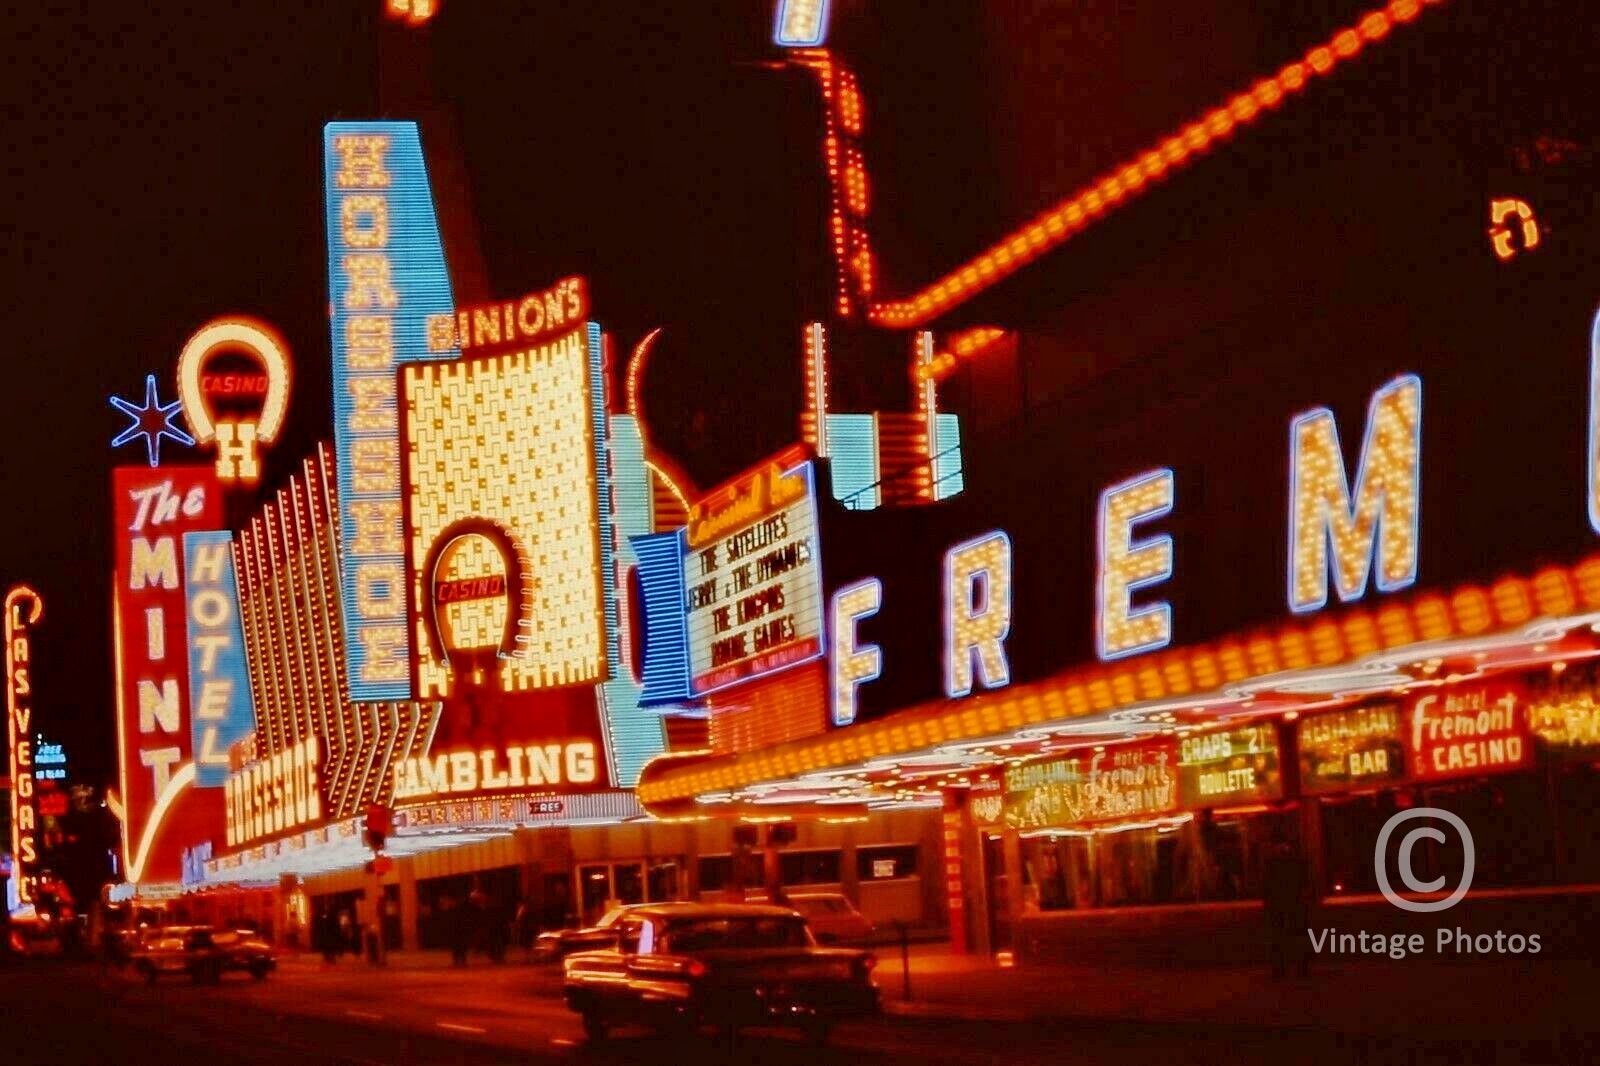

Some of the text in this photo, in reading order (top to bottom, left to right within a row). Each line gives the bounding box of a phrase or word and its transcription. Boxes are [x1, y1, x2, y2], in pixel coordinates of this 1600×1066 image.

[425, 276, 582, 352] BINION'S
[201, 376, 268, 393] CASINO
[332, 133, 408, 682] HORSESHOE
[215, 422, 258, 478] H
[129, 480, 206, 531] The
[699, 511, 788, 576] THE SATELLITES
[439, 578, 501, 601] CASINO
[732, 563, 752, 594] THE
[712, 604, 731, 634] THE
[13, 605, 30, 694] LAS
[129, 535, 182, 800] MINT
[189, 543, 232, 766] HOTEL
[394, 742, 596, 799] GAMBLING
[1182, 732, 1232, 763] CRAPS
[1350, 749, 1389, 776] BAR
[1433, 737, 1522, 771] CASINO
[15, 708, 36, 863] VEGAS
[1199, 768, 1255, 795] ROULETTE
[533, 801, 561, 814] FREE
